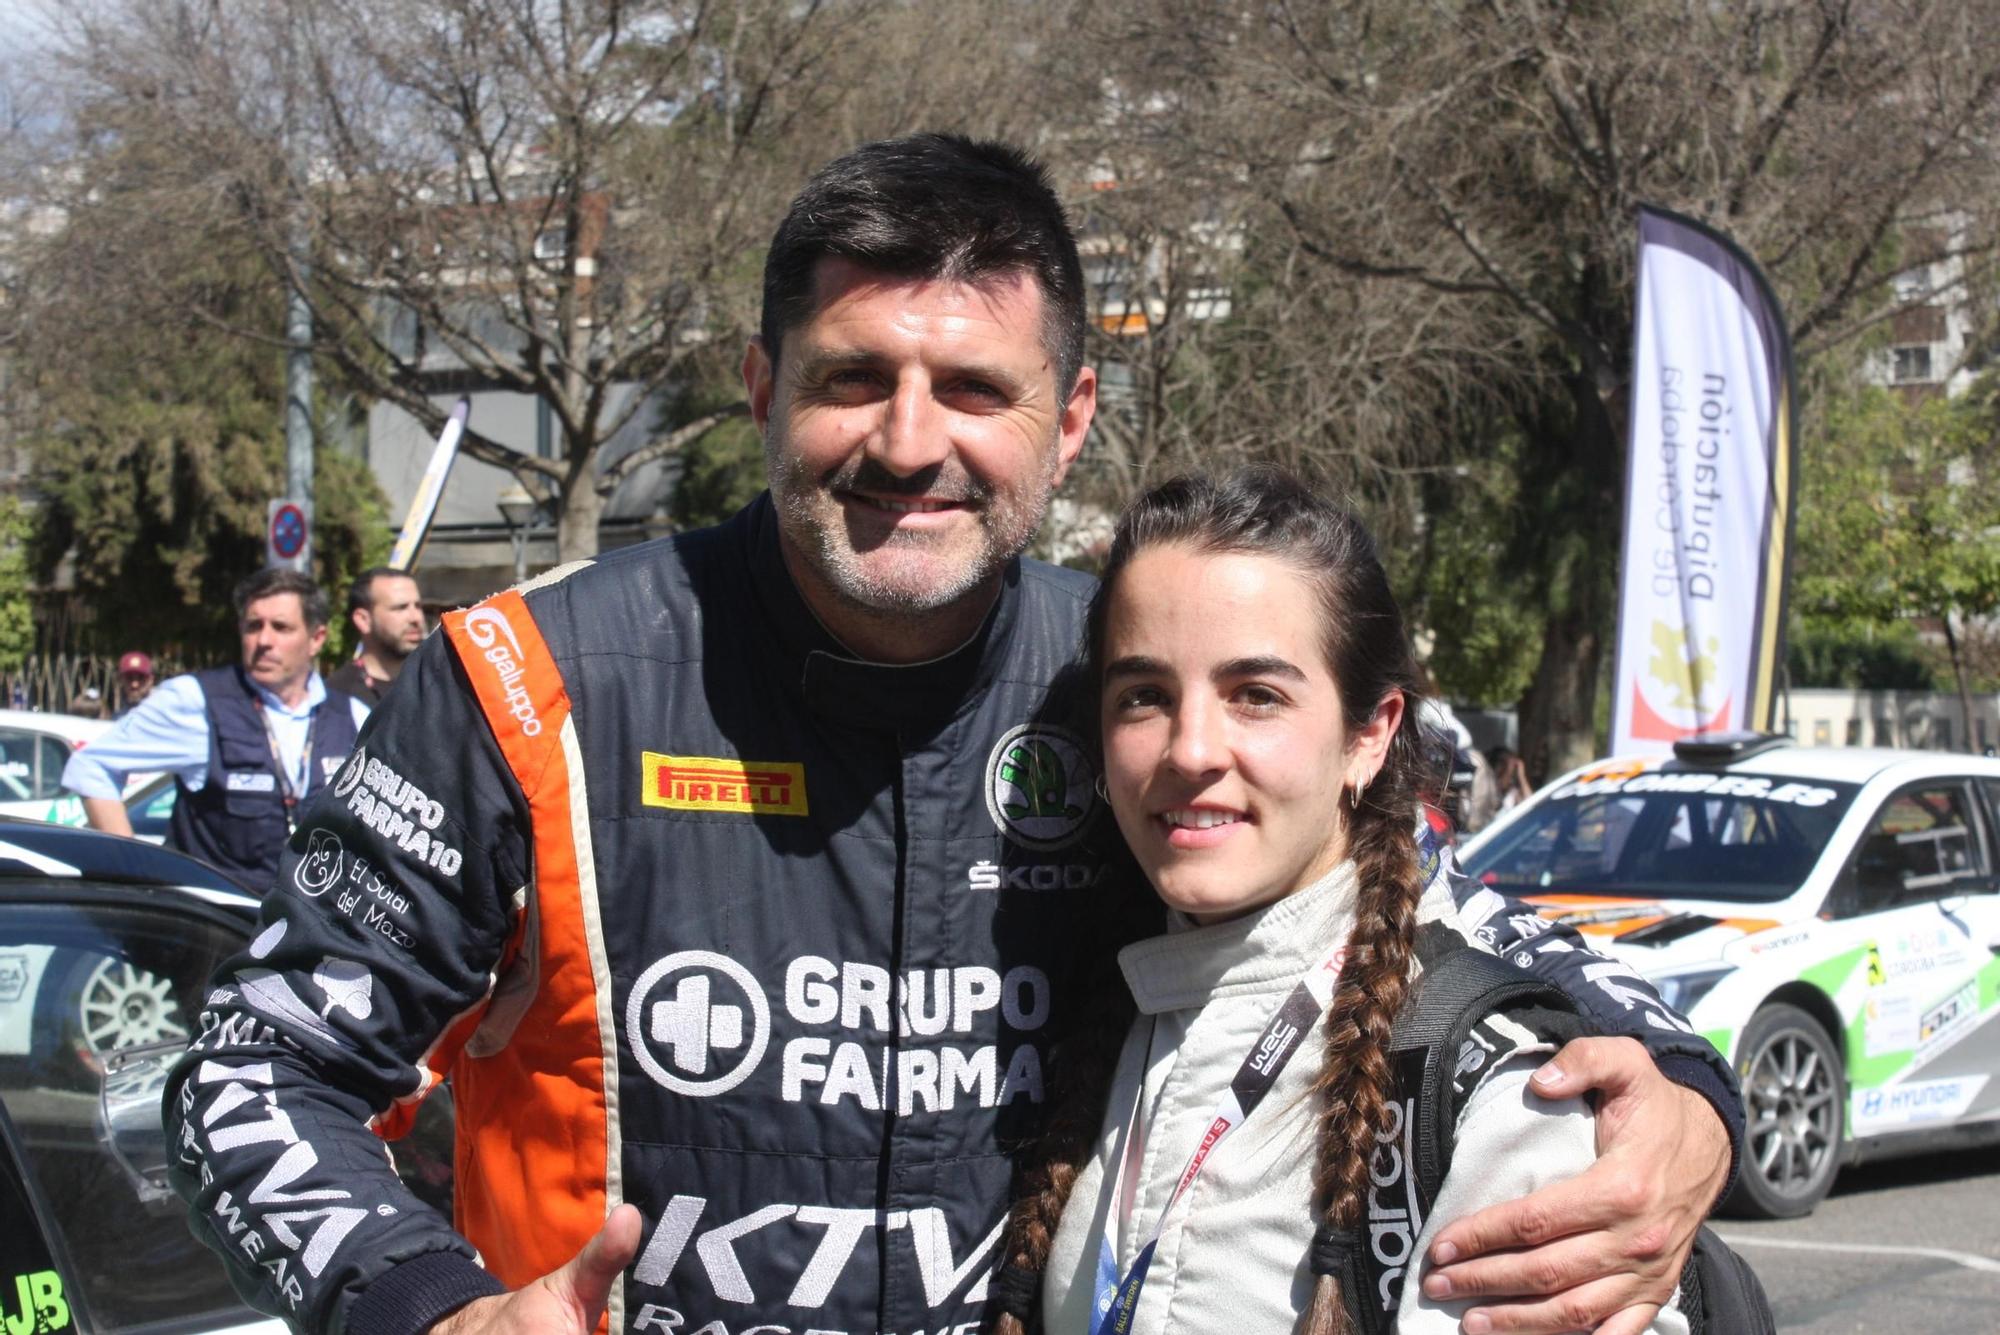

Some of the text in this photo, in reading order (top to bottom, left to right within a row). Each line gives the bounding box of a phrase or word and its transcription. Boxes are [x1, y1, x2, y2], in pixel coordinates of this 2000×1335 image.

[484, 646, 541, 736] galuppo
[363, 757, 444, 830] GRUPO
[657, 765, 793, 807] PIRELLI
[347, 785, 463, 877] FARMA10
[349, 857, 413, 915] El Solar
[337, 887, 417, 949] del Mazo
[785, 955, 1050, 1037] GRUPO
[1249, 1018, 1292, 1071] WRC
[1891, 1084, 1961, 1107] HYUNDAI
[214, 1190, 304, 1311] WEAR
[1114, 1279, 1140, 1334] RALLY SWEDEN
